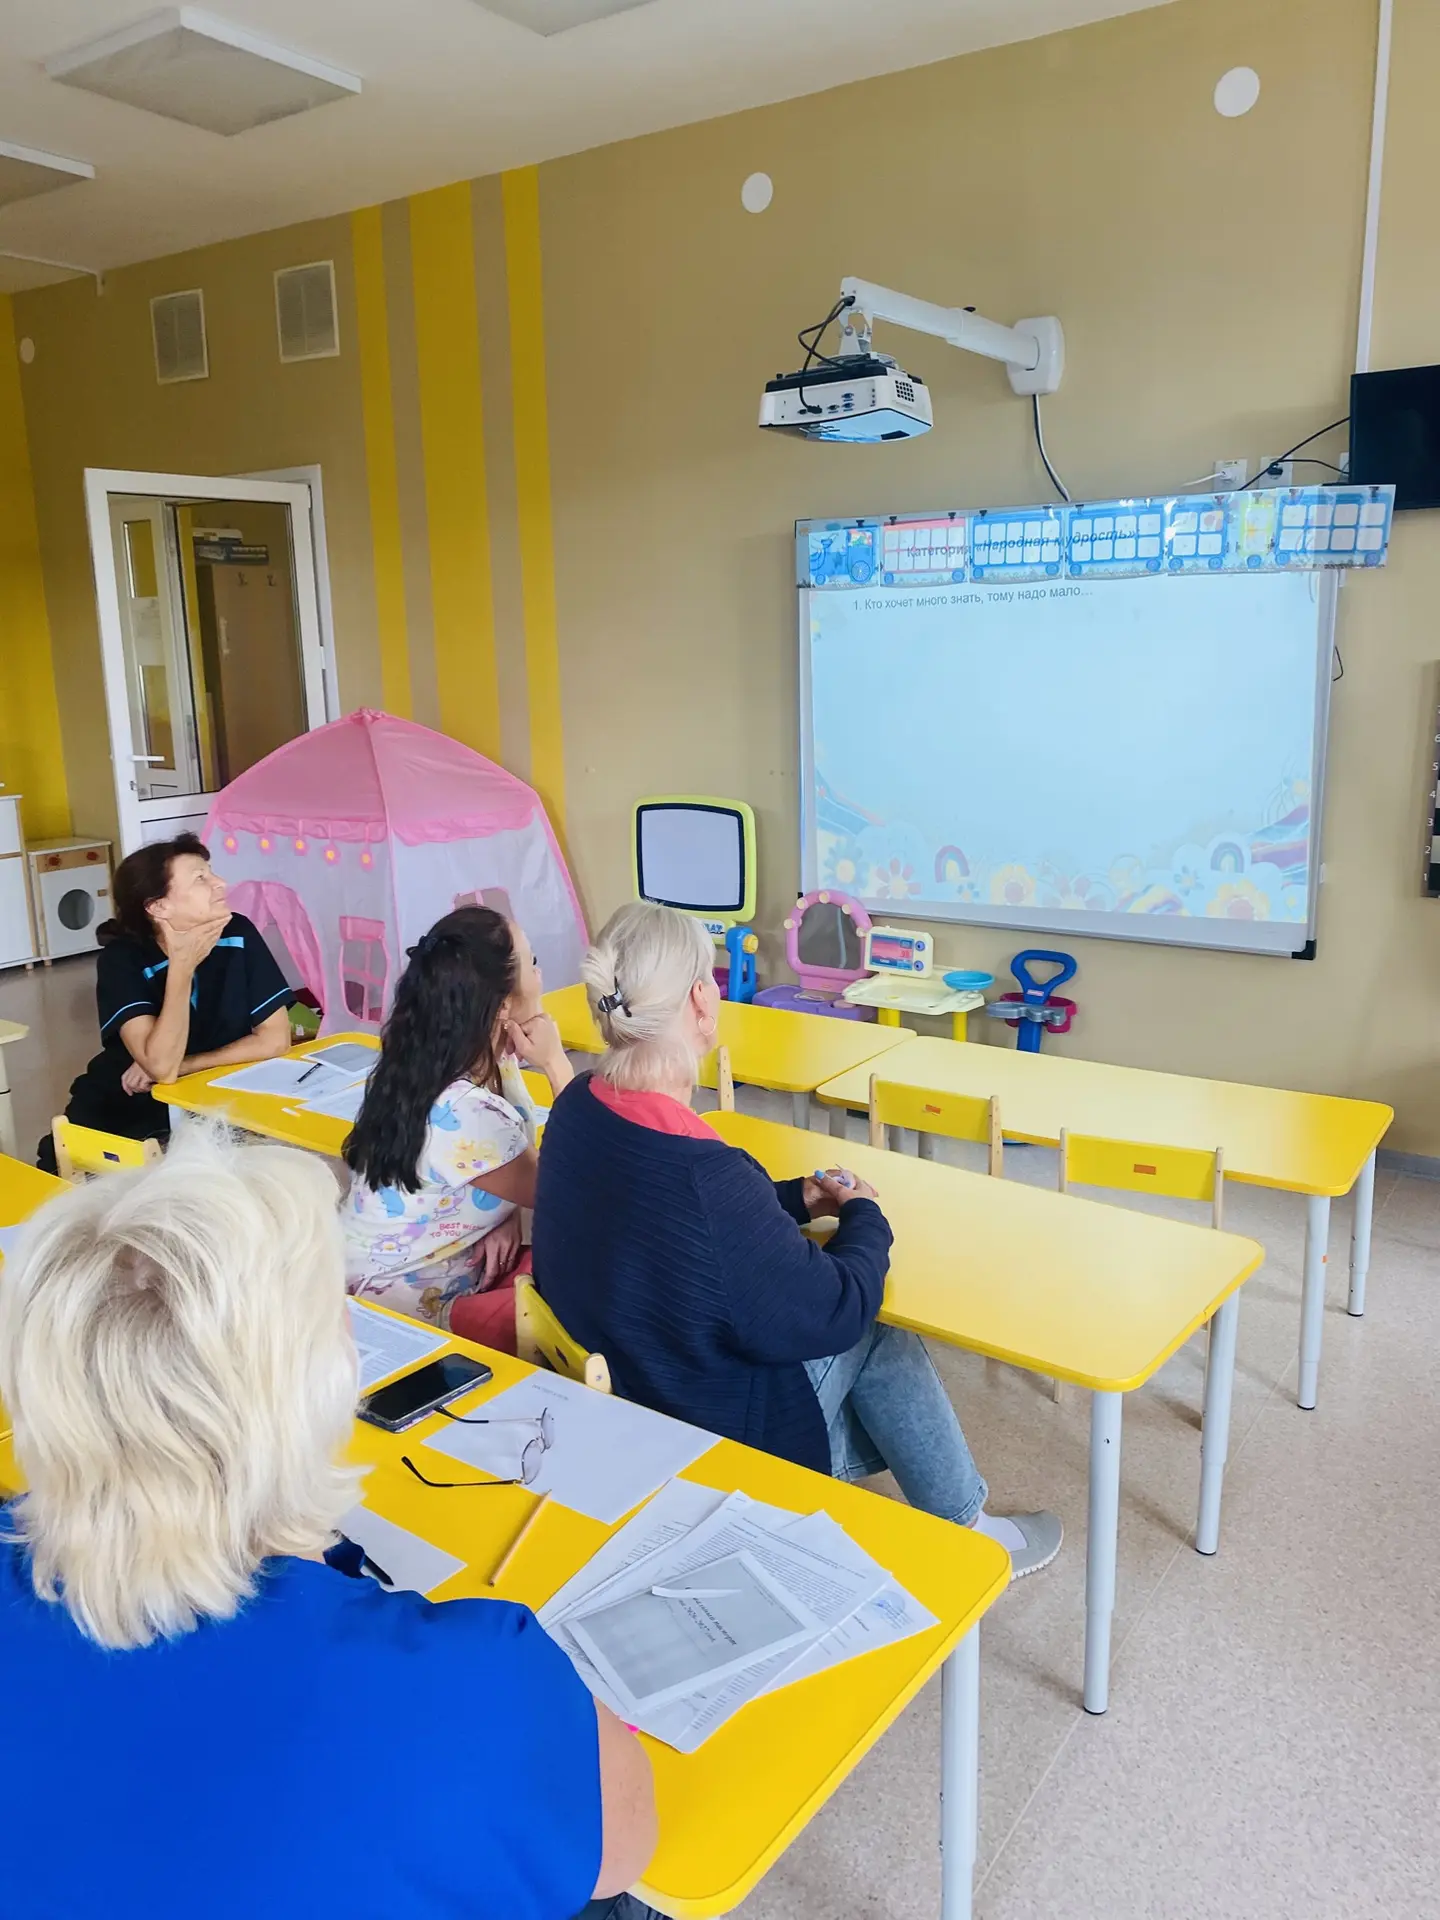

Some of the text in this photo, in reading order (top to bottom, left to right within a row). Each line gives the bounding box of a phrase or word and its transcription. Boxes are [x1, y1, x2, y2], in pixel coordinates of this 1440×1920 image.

[907, 545, 971, 558] Категория
[976, 535, 1049, 553] «Народная
[854, 600, 862, 610] 1.
[865, 598, 882, 610] Кто
[885, 597, 912, 608] хочет
[916, 595, 947, 607] много
[950, 594, 983, 605] знать,
[987, 591, 1014, 603] тому
[1018, 589, 1046, 600] надо
[1432, 762, 1438, 771] 5
[1429, 790, 1437, 799] 4
[1427, 817, 1434, 827] 3
[1424, 846, 1431, 854] 2
[1423, 873, 1428, 882] 1
